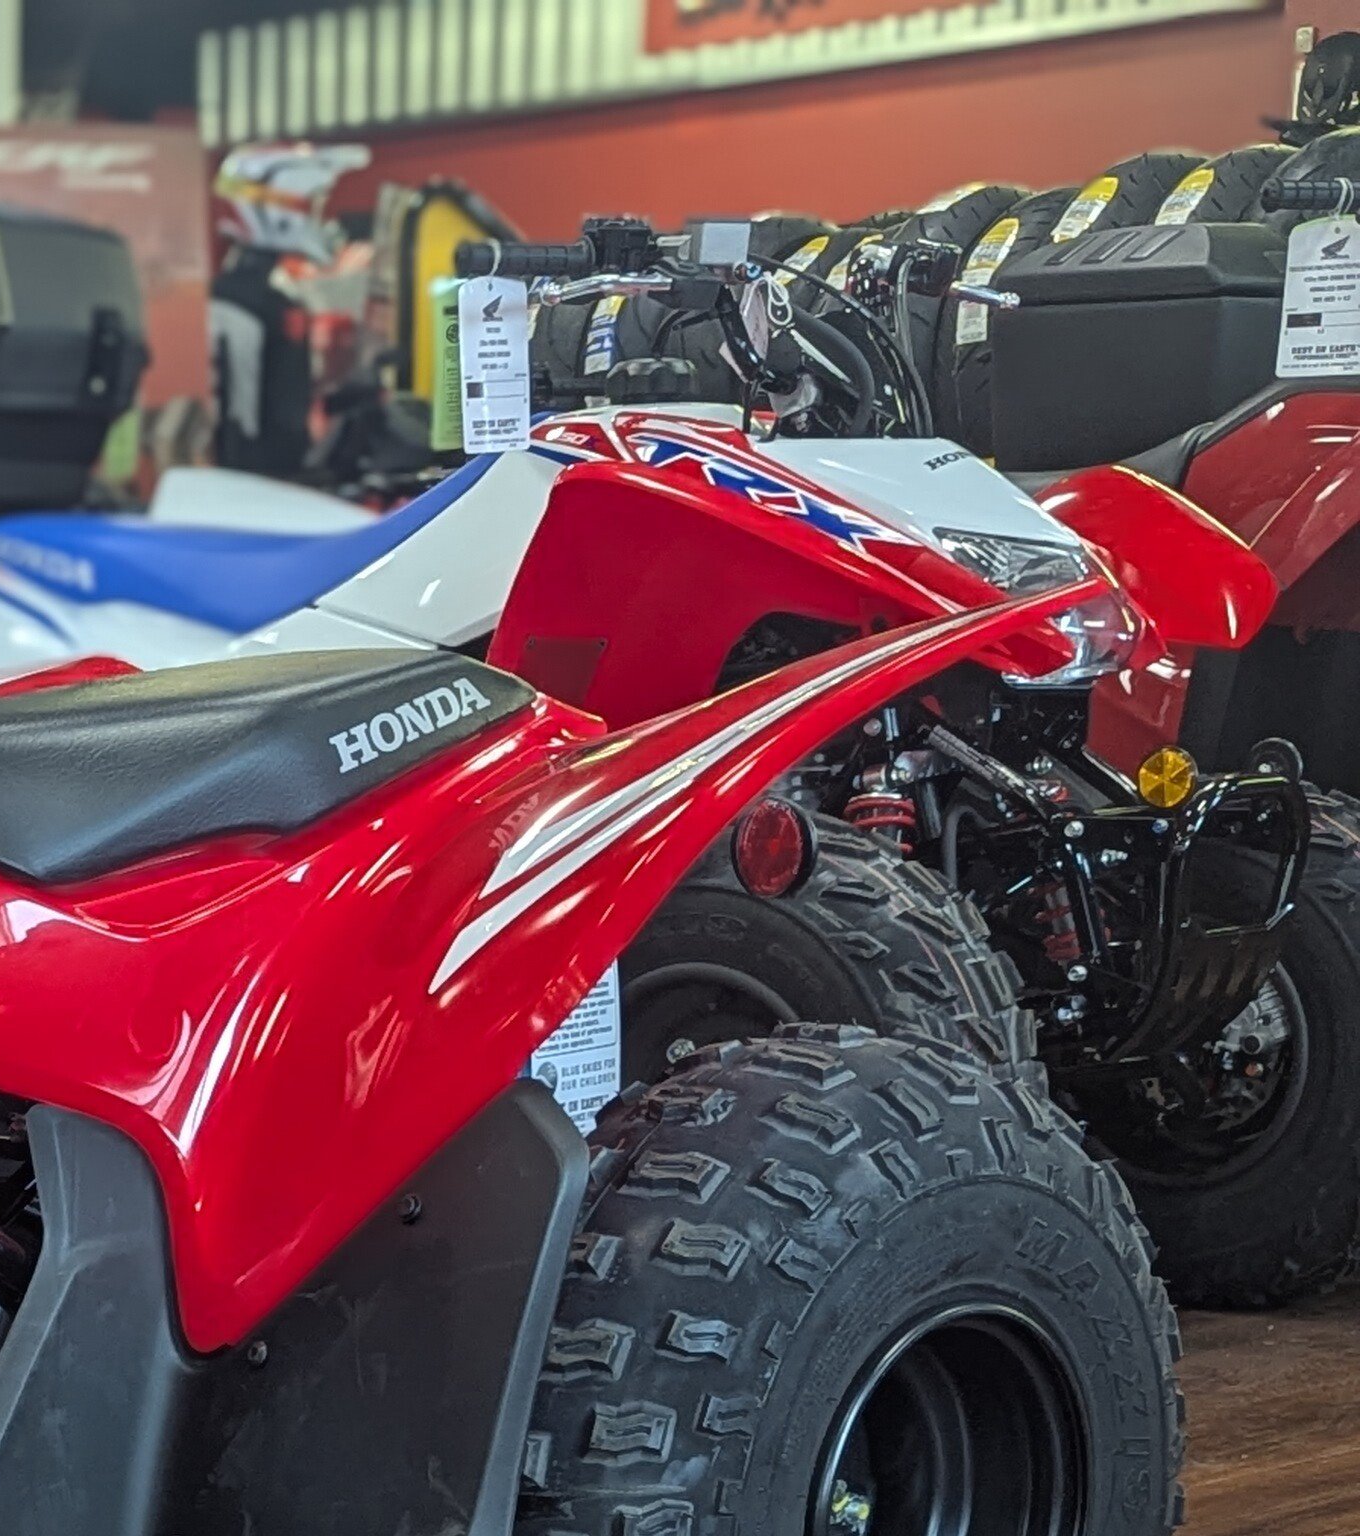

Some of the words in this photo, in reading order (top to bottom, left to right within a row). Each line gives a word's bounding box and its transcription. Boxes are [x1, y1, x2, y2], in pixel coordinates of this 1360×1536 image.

[328, 677, 491, 774] HONDA
[561, 1065, 581, 1078] BLUE
[582, 1060, 603, 1074] SKIES
[603, 1057, 616, 1070] FOR
[561, 1079, 577, 1091] OUR
[579, 1072, 616, 1088] CHILDREN
